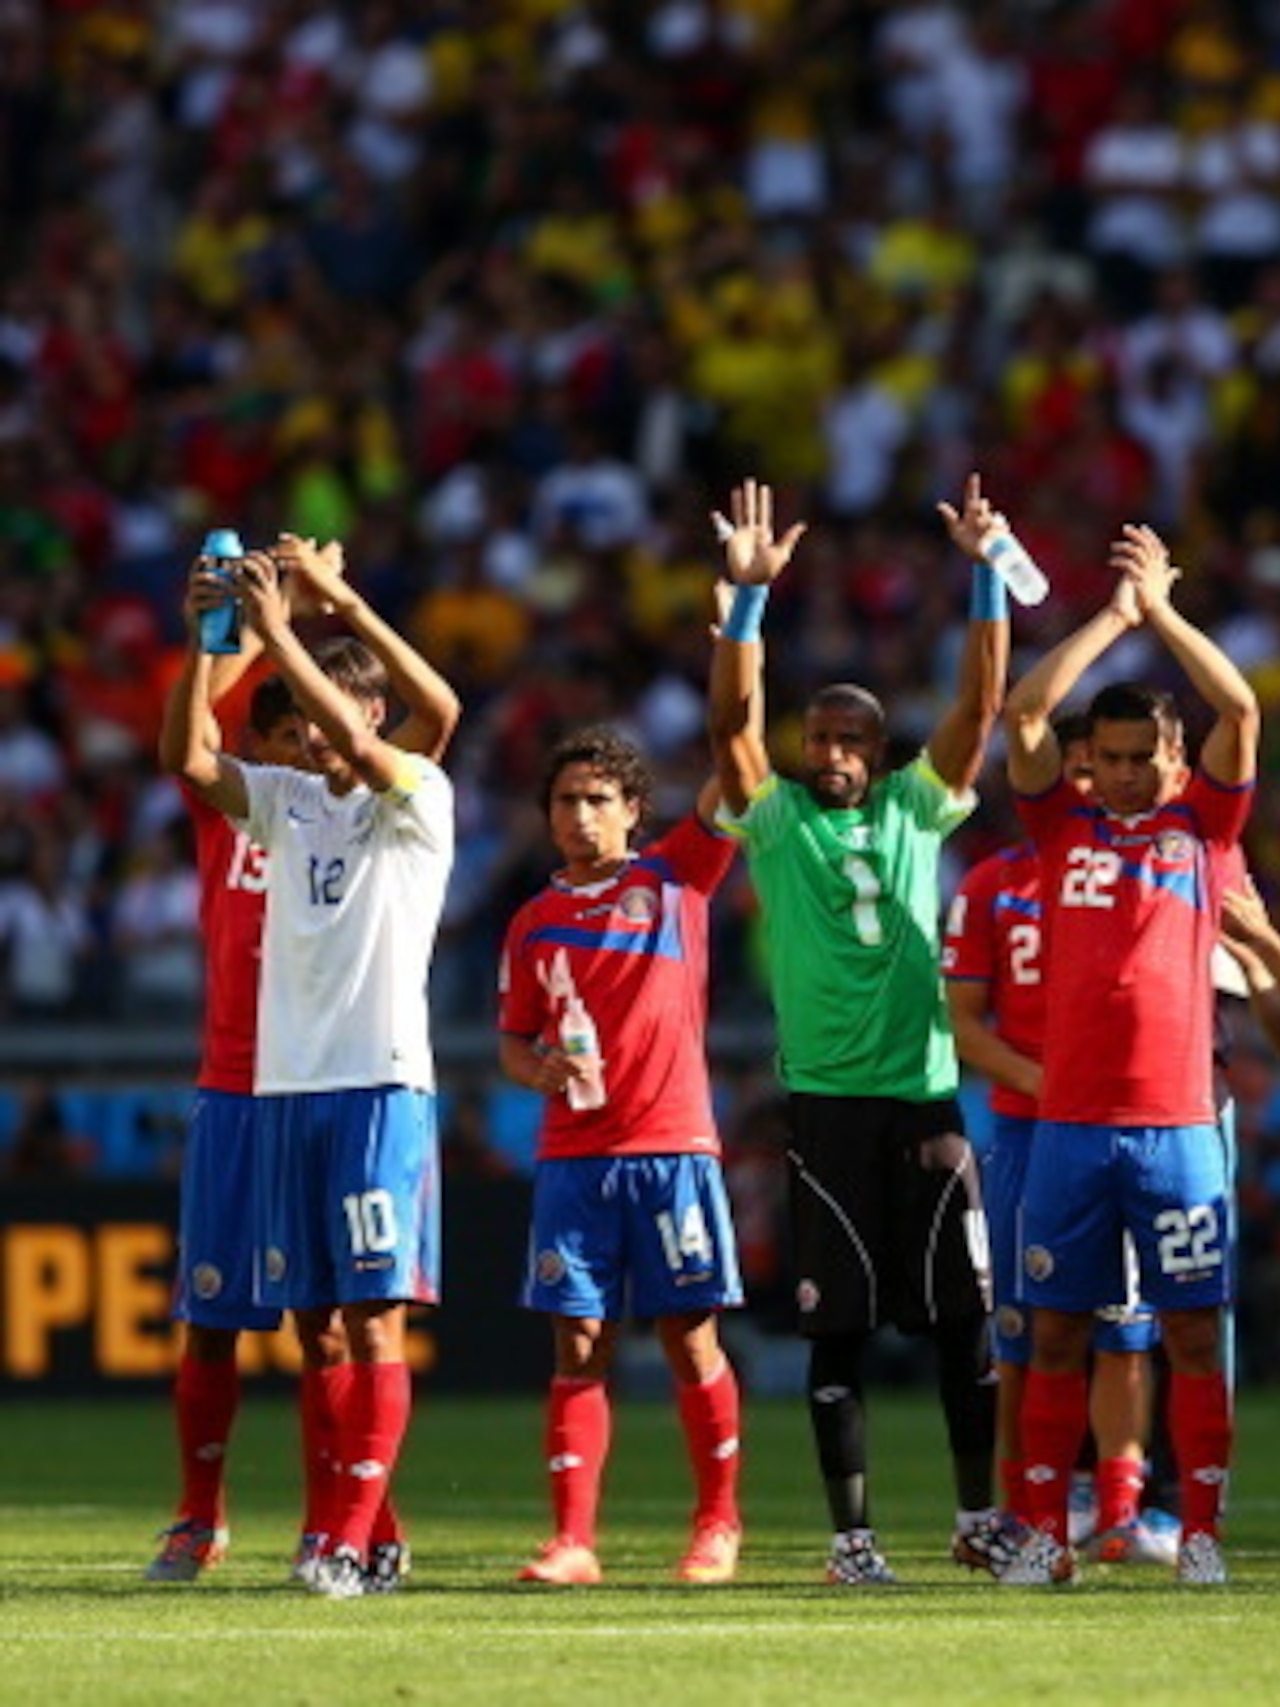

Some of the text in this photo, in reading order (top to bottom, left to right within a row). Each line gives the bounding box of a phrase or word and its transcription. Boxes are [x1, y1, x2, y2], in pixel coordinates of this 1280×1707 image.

[309, 852, 346, 906] 12
[842, 852, 881, 946] 1
[1060, 846, 1123, 909] 22
[343, 1188, 398, 1256] 10
[655, 1204, 714, 1270] 14
[1153, 1205, 1223, 1274] 22
